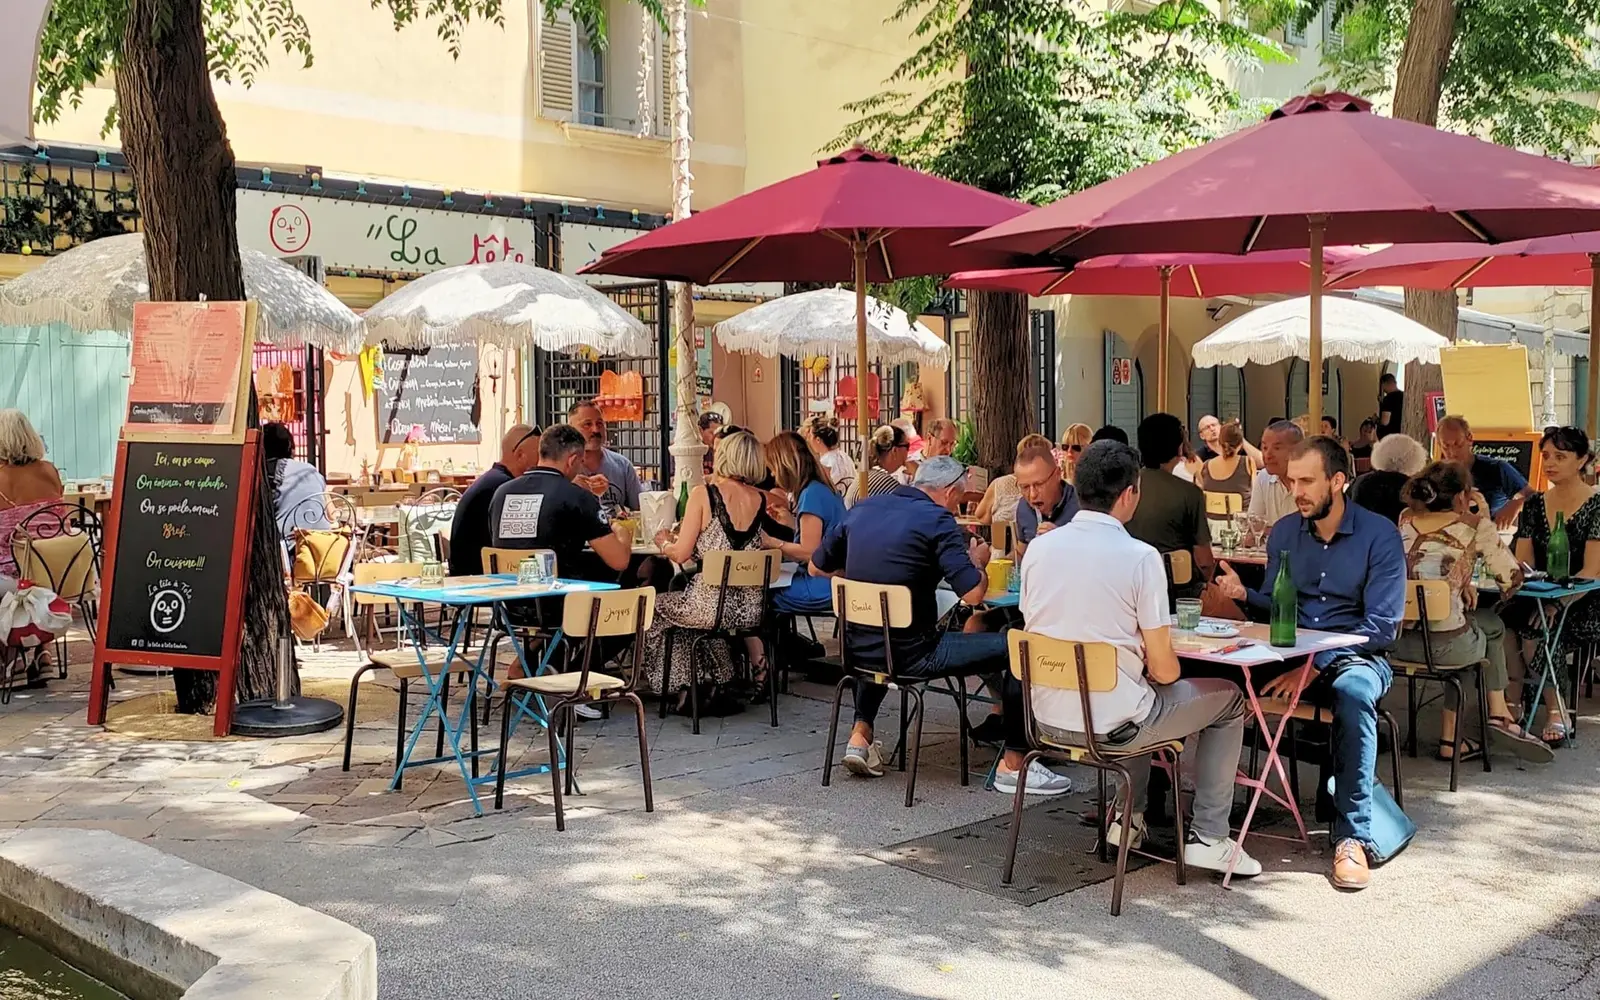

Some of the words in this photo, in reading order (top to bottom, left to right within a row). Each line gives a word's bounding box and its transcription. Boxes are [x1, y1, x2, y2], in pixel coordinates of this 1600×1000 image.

[154, 452, 170, 467] Ici,
[182, 457, 192, 467] se
[194, 456, 216, 468] coupe
[136, 474, 153, 490] On
[184, 479, 196, 489] on
[140, 498, 155, 515] On
[157, 504, 167, 515] se
[507, 497, 539, 513] ST
[501, 521, 537, 536] F83
[146, 550, 162, 569] On
[148, 584, 158, 597] La
[1036, 655, 1068, 673] Tanguy
